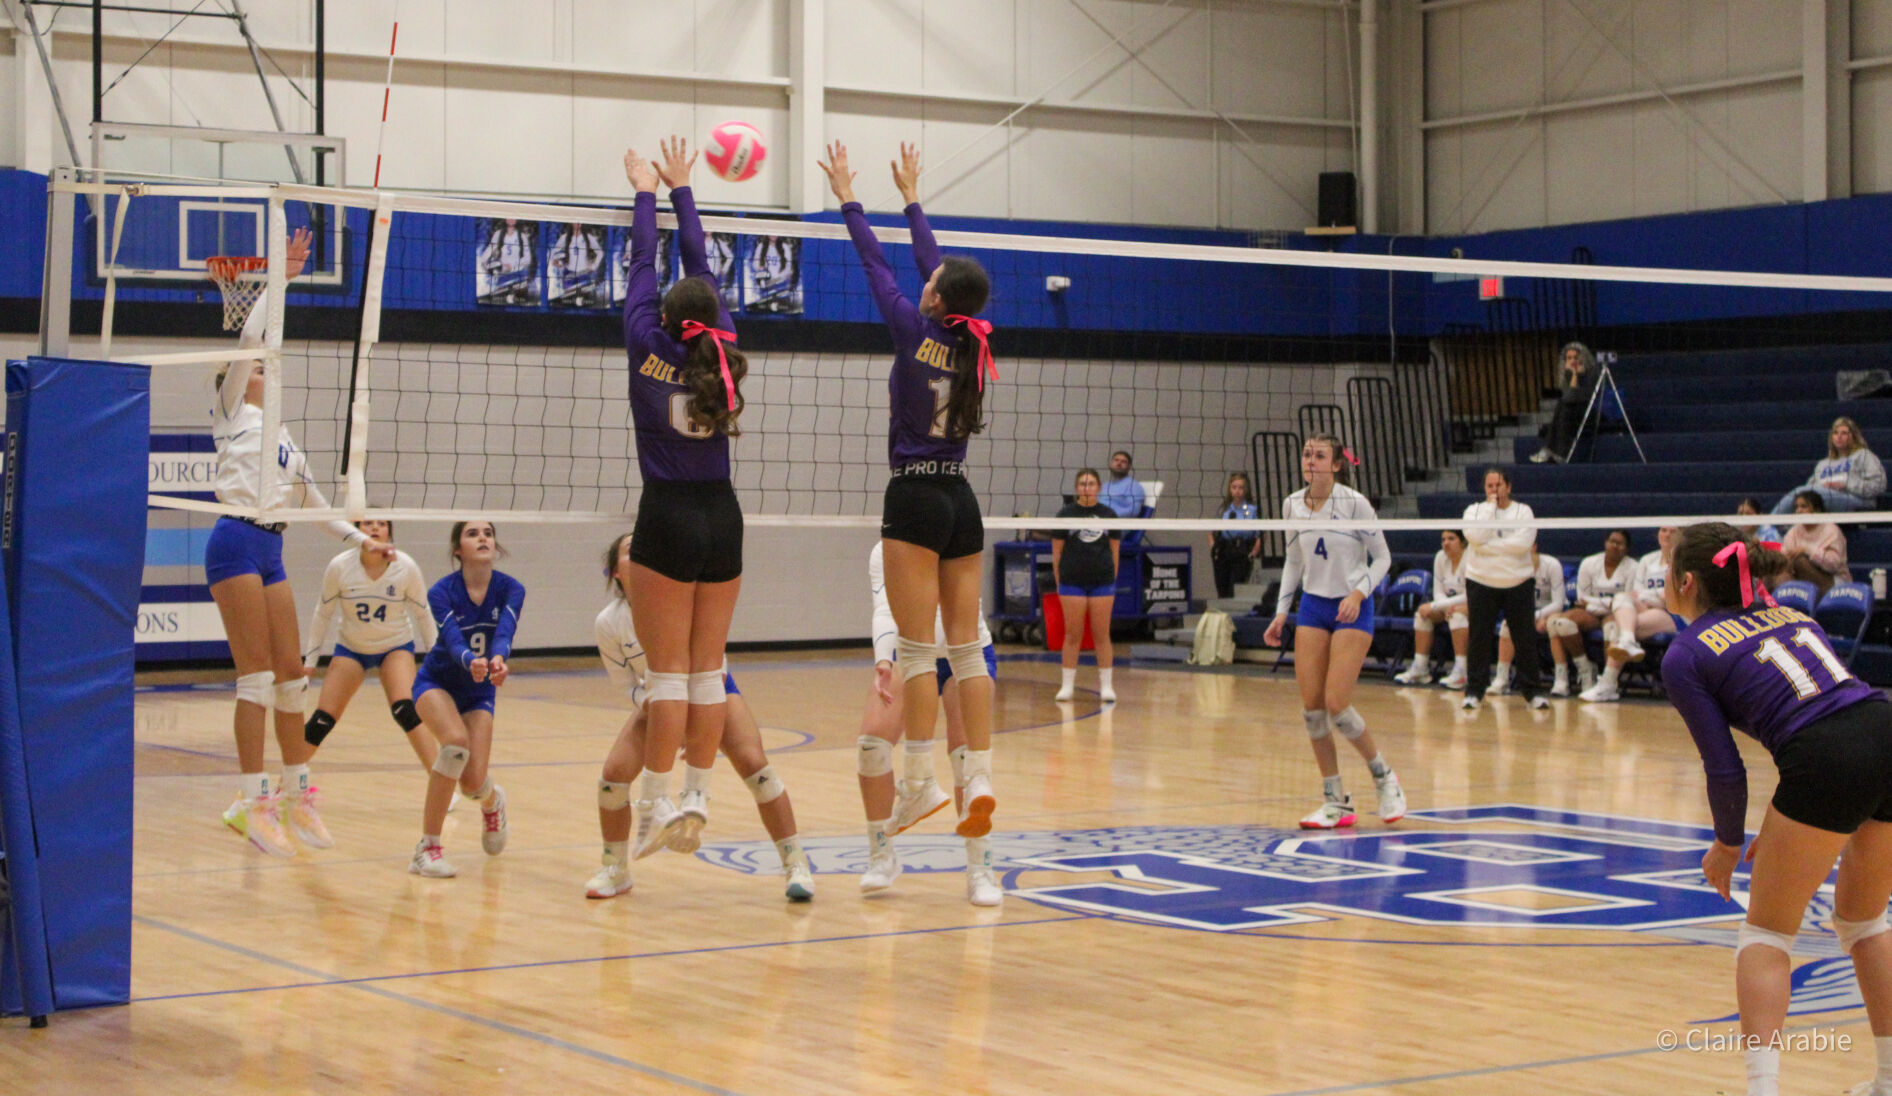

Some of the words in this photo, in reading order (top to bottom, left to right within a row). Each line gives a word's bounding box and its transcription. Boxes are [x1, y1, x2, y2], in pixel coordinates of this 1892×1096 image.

[905, 461, 937, 475] PRO
[1314, 537, 1328, 560] 4
[355, 603, 387, 622] 24
[1697, 605, 1817, 657] BULLDOG
[470, 632, 486, 657] 9
[1753, 627, 1854, 701] 11
